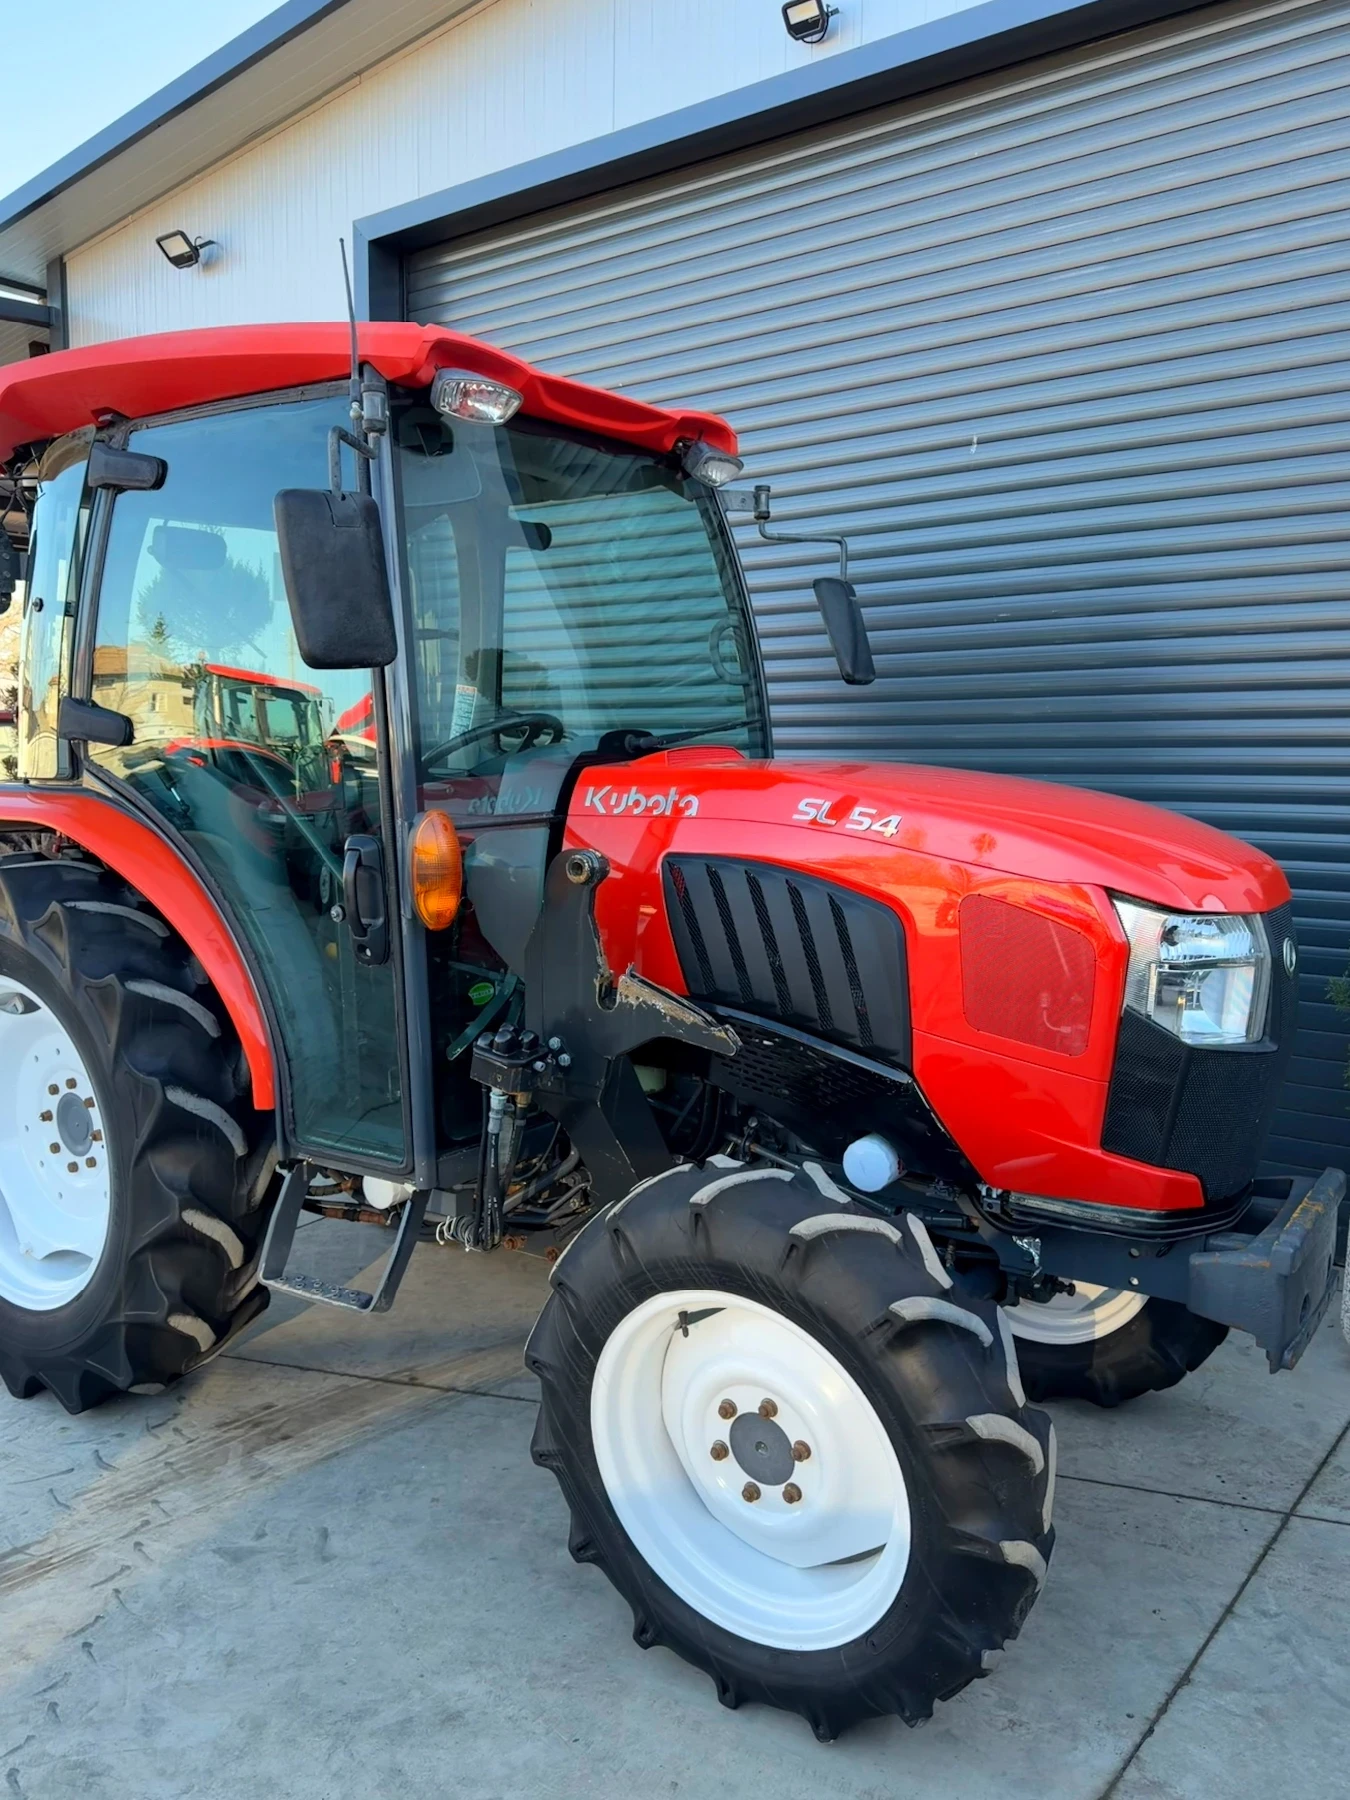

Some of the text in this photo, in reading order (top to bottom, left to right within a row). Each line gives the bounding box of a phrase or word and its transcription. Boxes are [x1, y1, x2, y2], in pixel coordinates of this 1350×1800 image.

[584, 785, 699, 816] Kubota
[792, 798, 902, 838] SL 54
